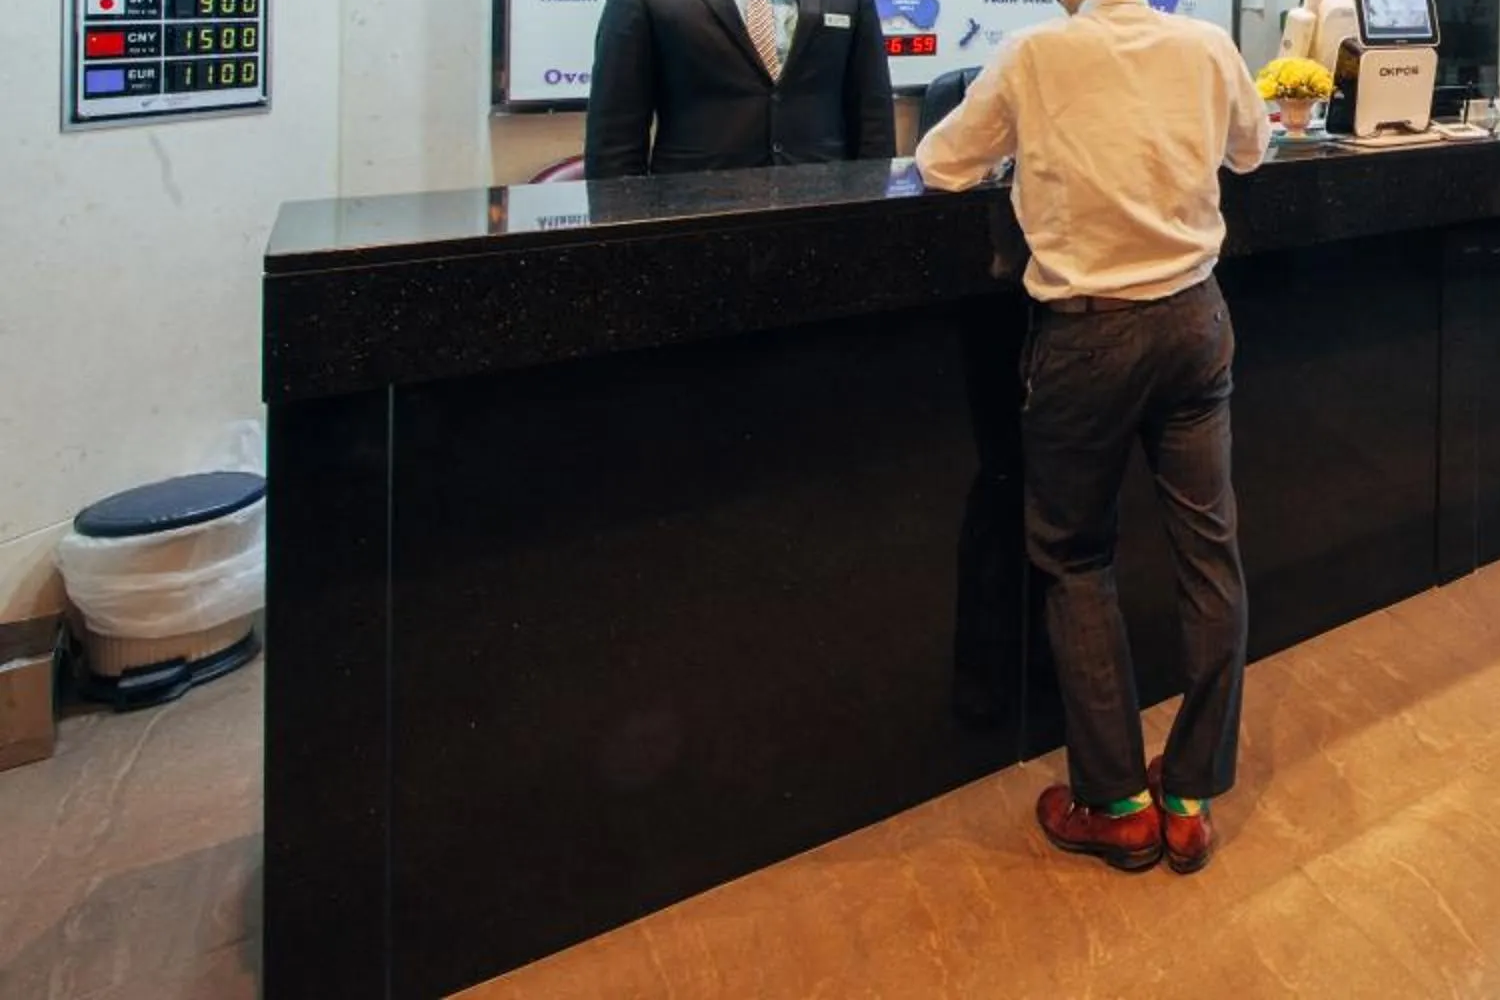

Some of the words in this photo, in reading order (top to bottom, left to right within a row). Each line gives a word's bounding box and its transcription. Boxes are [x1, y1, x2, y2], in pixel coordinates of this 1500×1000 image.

[127, 32, 157, 43] CNY
[186, 27, 256, 49] 1500
[128, 69, 155, 80] EUR
[185, 62, 255, 85] 1100
